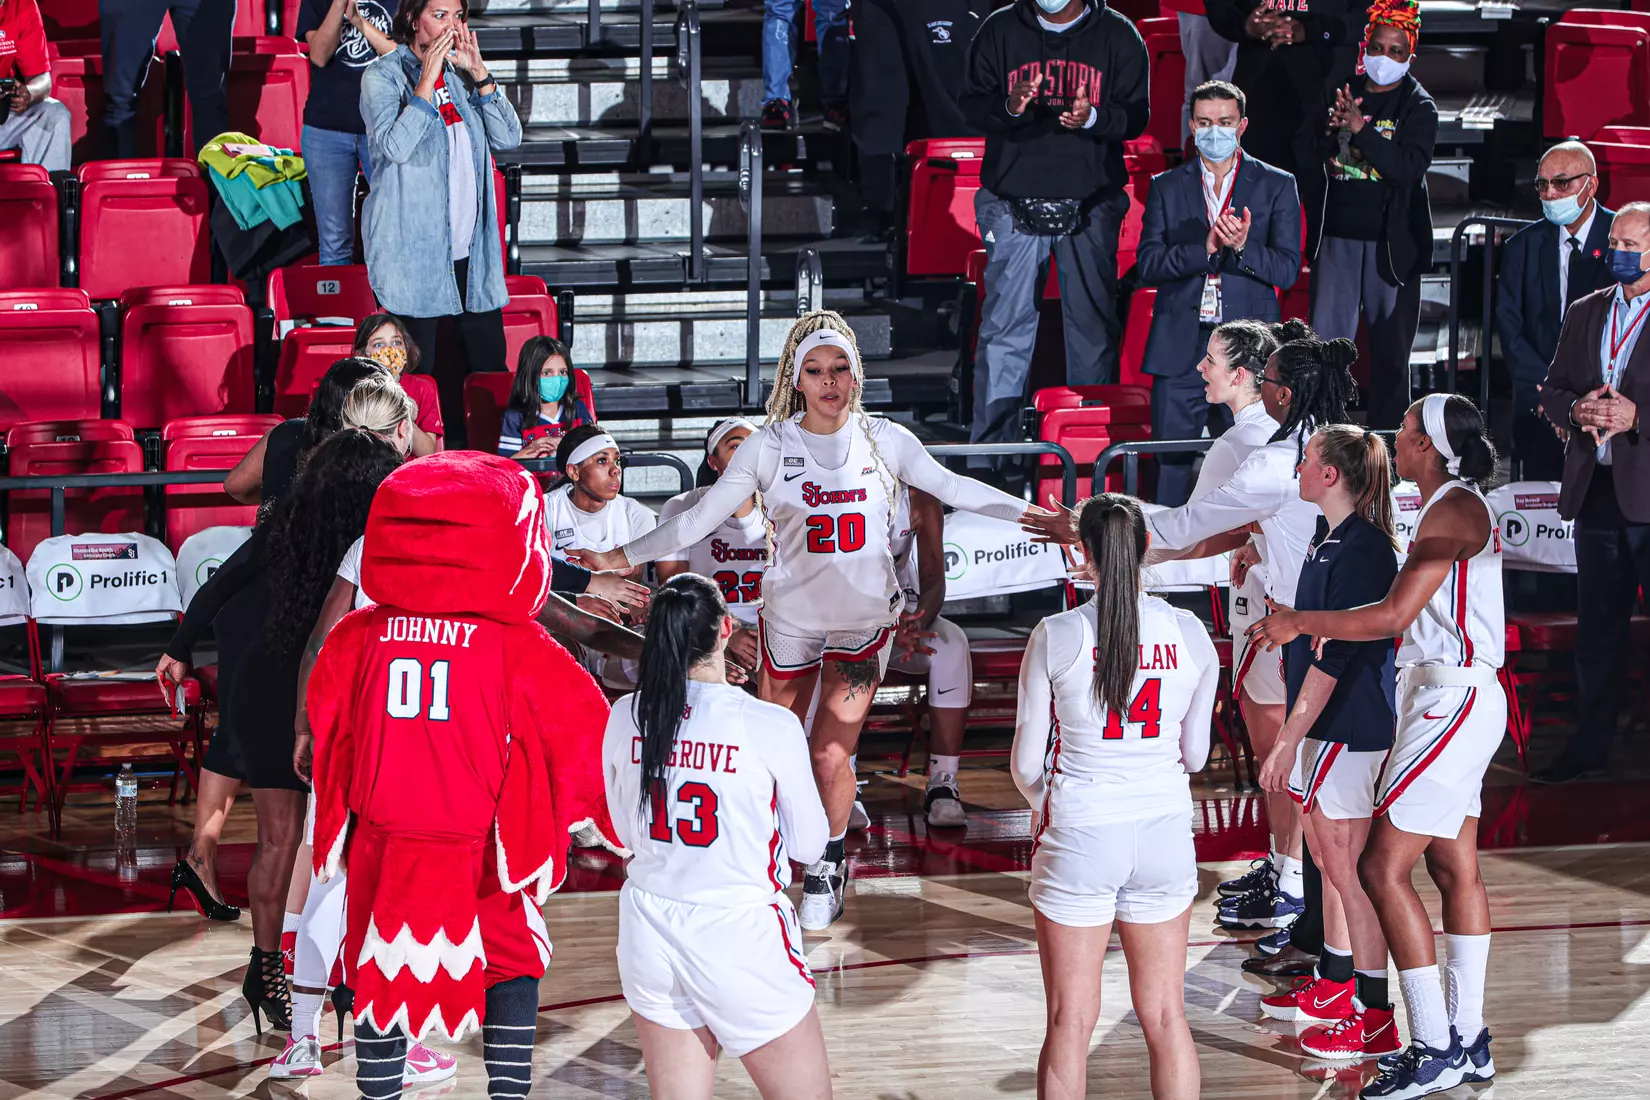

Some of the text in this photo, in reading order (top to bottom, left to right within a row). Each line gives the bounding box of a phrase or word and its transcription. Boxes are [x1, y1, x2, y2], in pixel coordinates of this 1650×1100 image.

[1043, 59, 1103, 107] STORM
[321, 282, 336, 293] 12
[805, 512, 866, 554] 20
[379, 616, 478, 648] JOHNNY
[387, 657, 451, 721] 01
[1102, 677, 1162, 740] 14
[647, 777, 719, 848] 13
